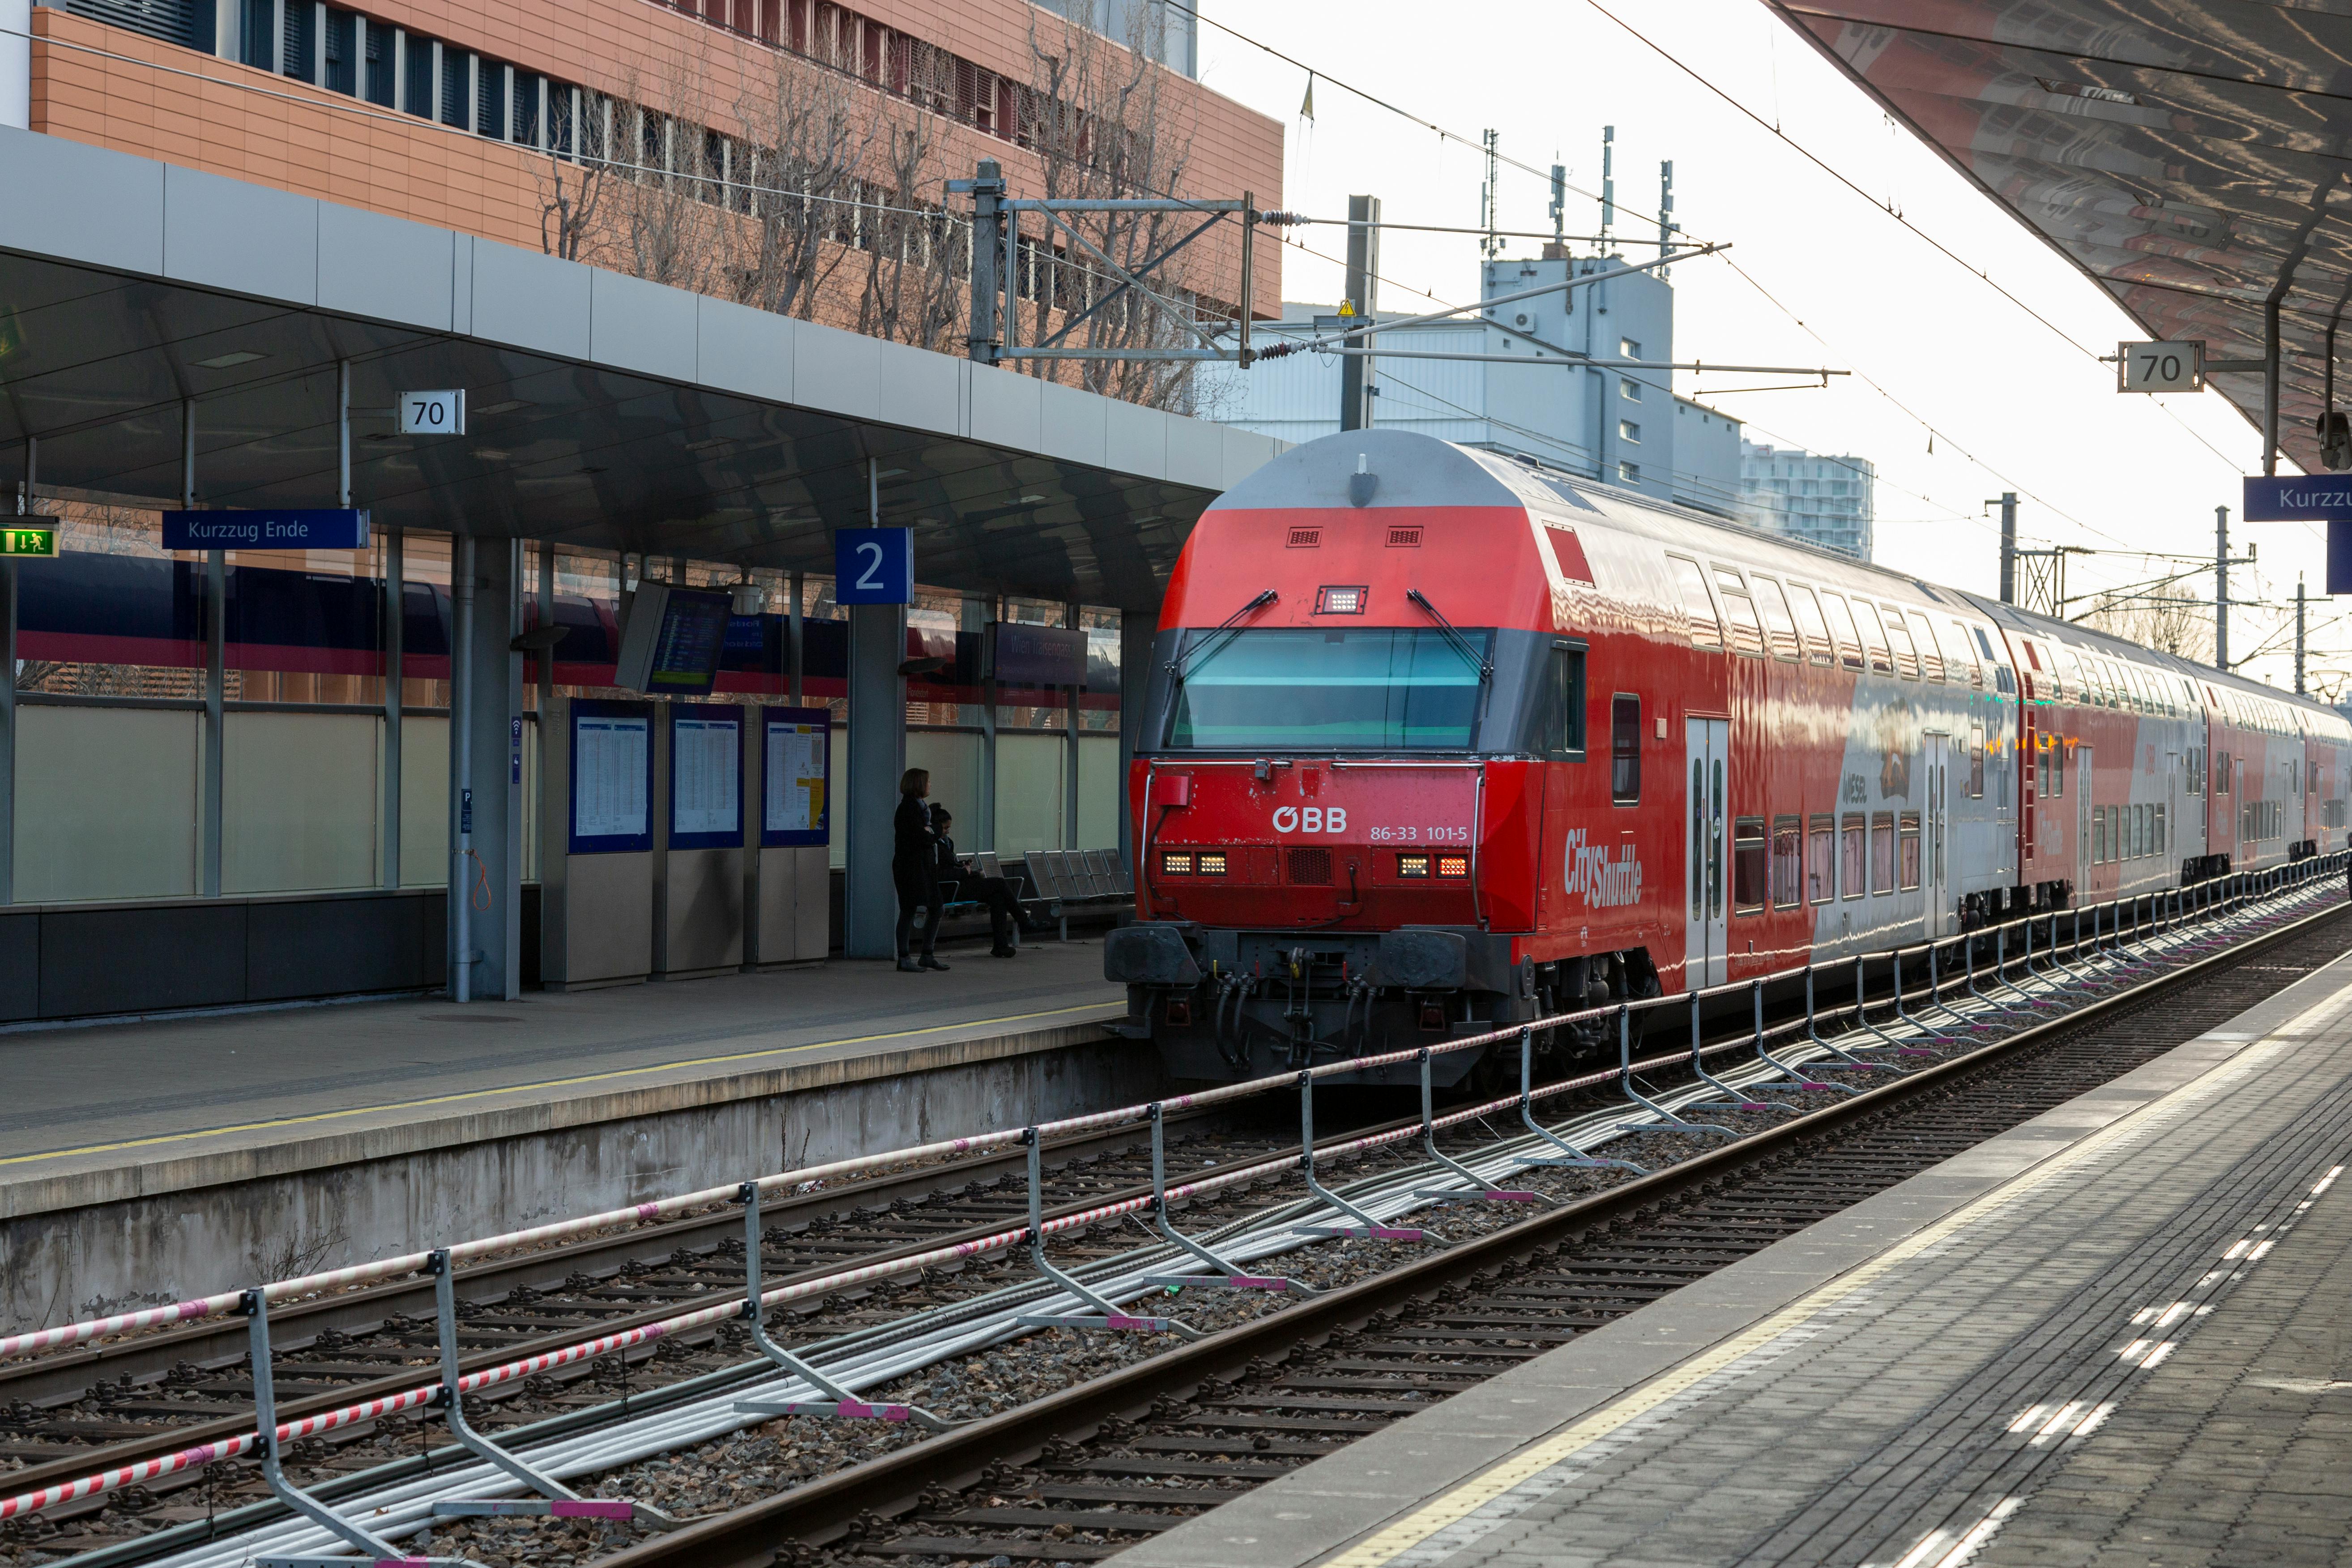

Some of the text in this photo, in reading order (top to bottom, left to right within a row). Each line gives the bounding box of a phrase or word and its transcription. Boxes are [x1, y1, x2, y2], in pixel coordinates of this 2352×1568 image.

[2140, 355, 2181, 382] 70
[412, 402, 444, 426] 70
[189, 521, 308, 542] Kurzzug Ende
[856, 542, 884, 590] 2
[1843, 769, 1867, 805] WIESEL
[1272, 806, 1347, 833] ÖBB
[1370, 827, 1468, 841] 86-33 101-5
